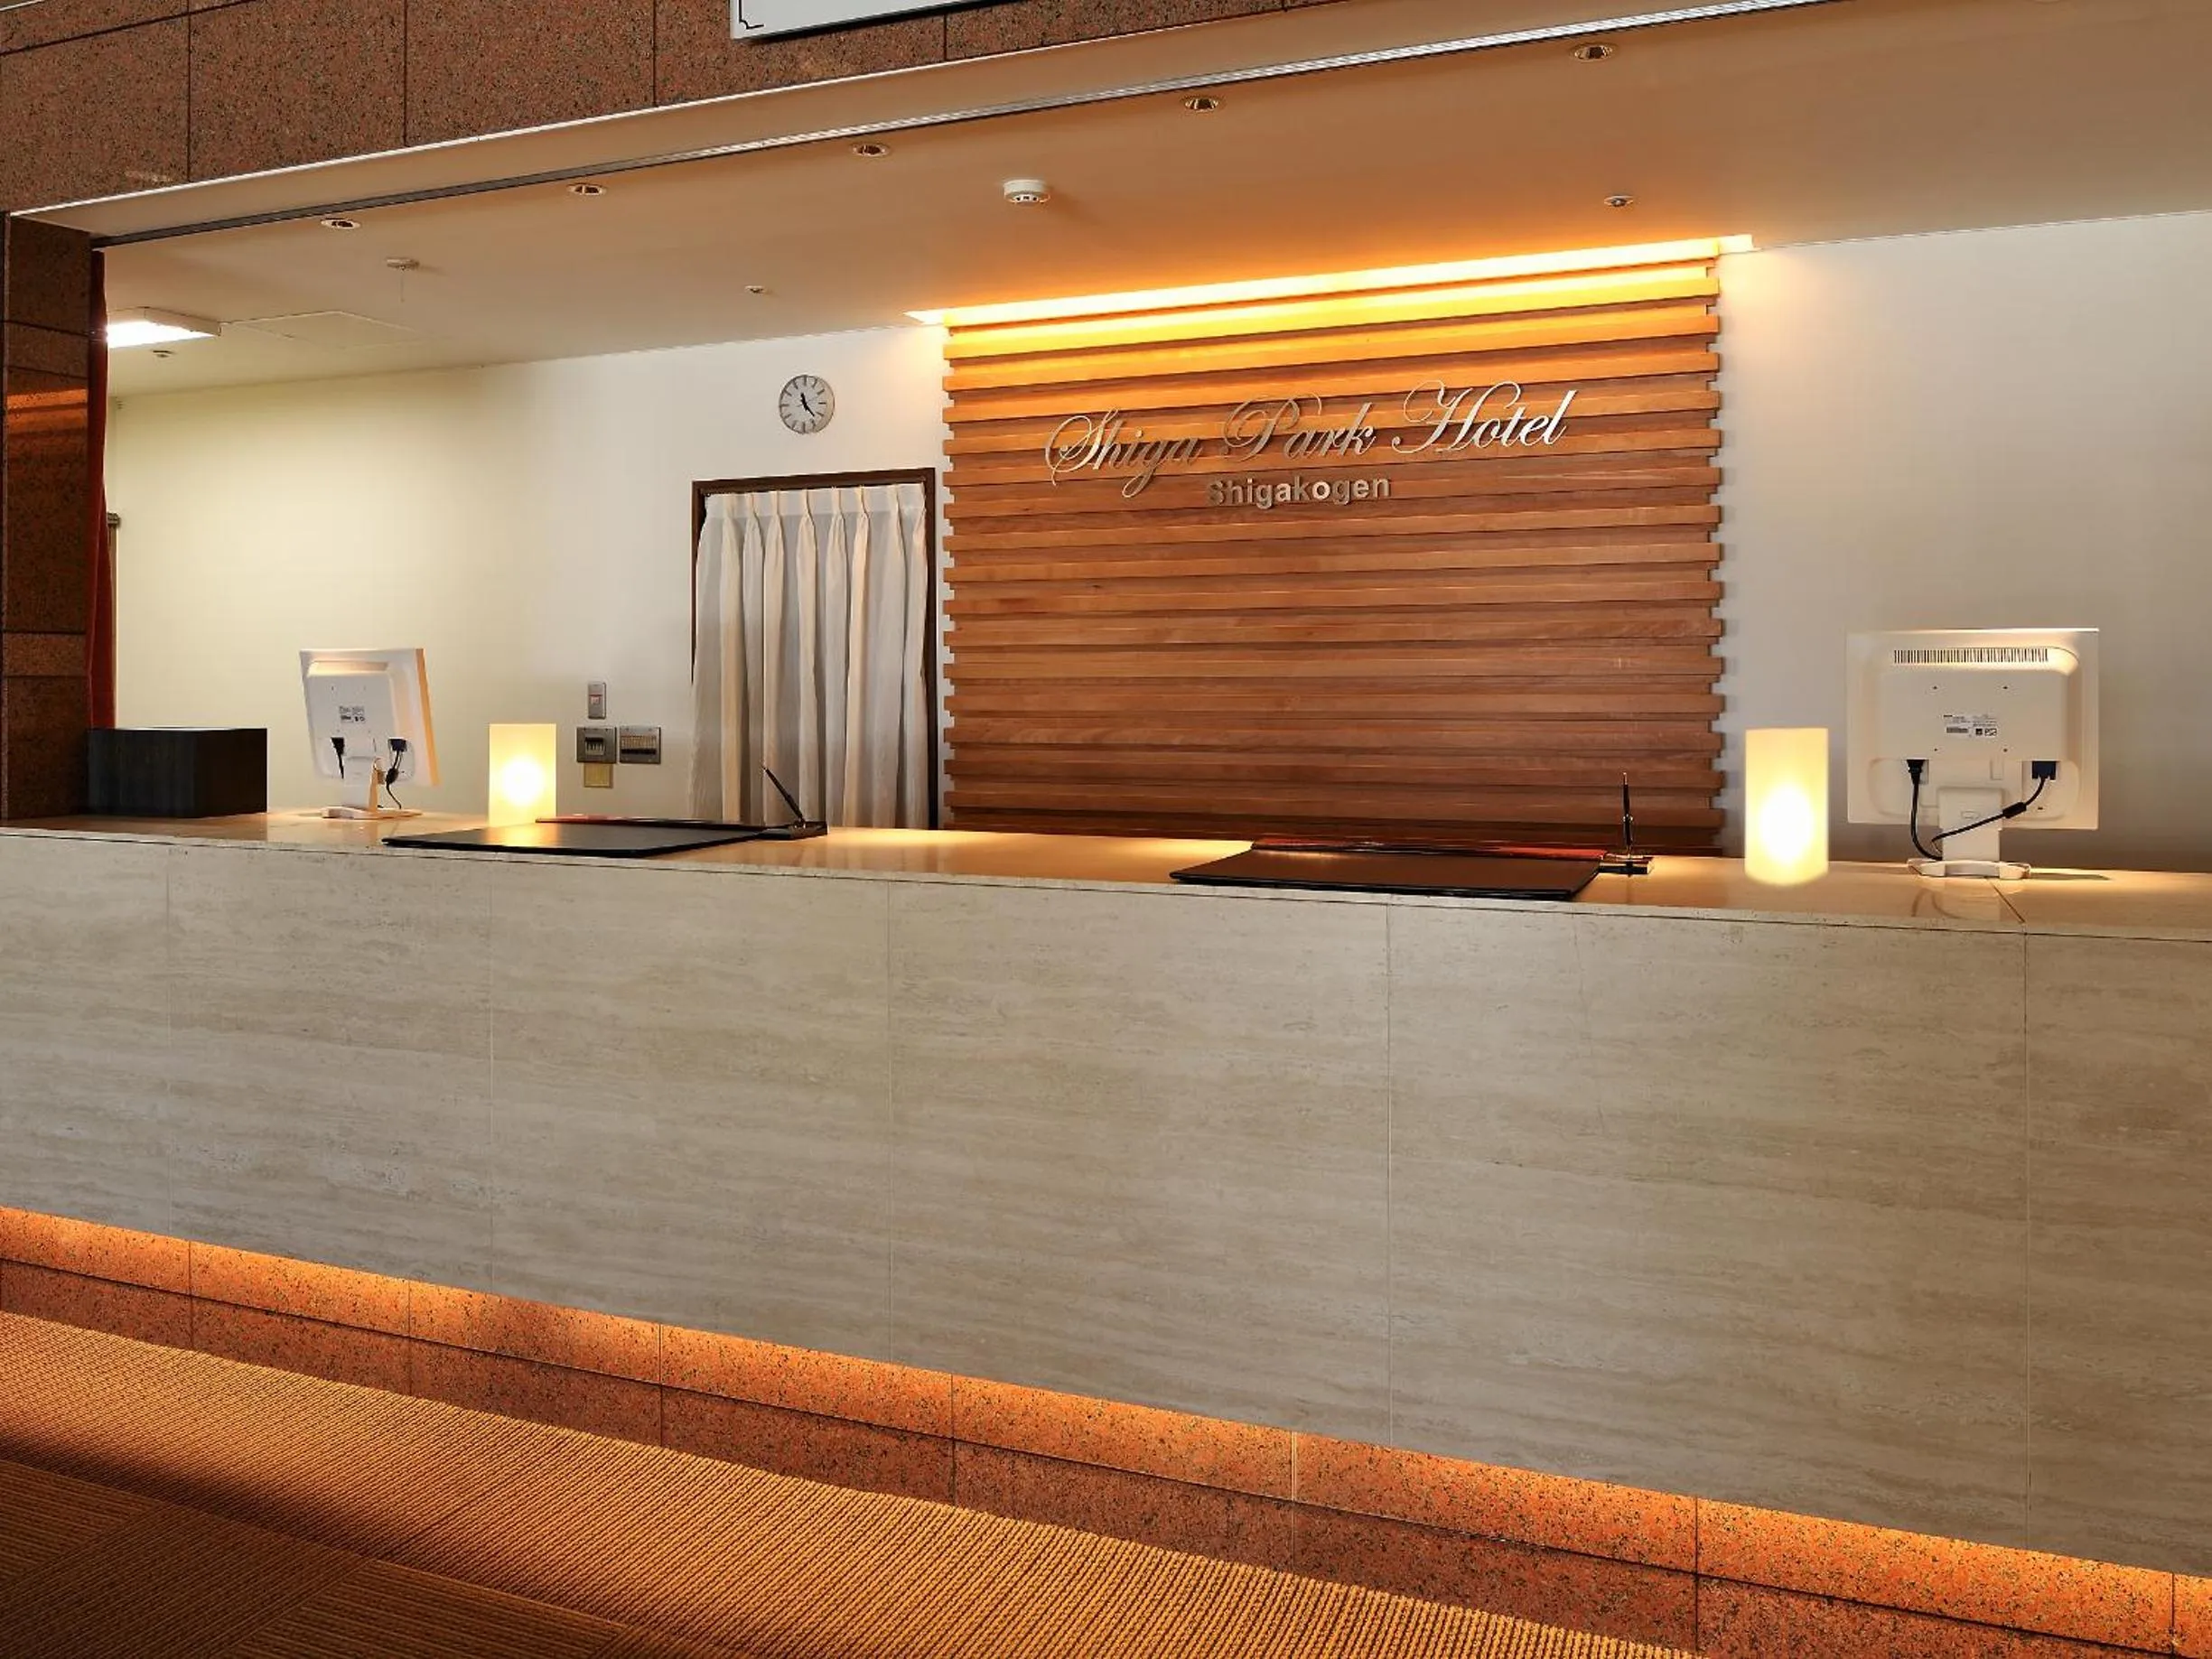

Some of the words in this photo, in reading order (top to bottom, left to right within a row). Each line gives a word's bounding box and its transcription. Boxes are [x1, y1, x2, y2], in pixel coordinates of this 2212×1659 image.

[1045, 405, 1203, 498] Shiga
[1222, 392, 1376, 462] Park
[1392, 380, 1577, 453] Hotel
[1208, 476, 1390, 509] Shigakogen
